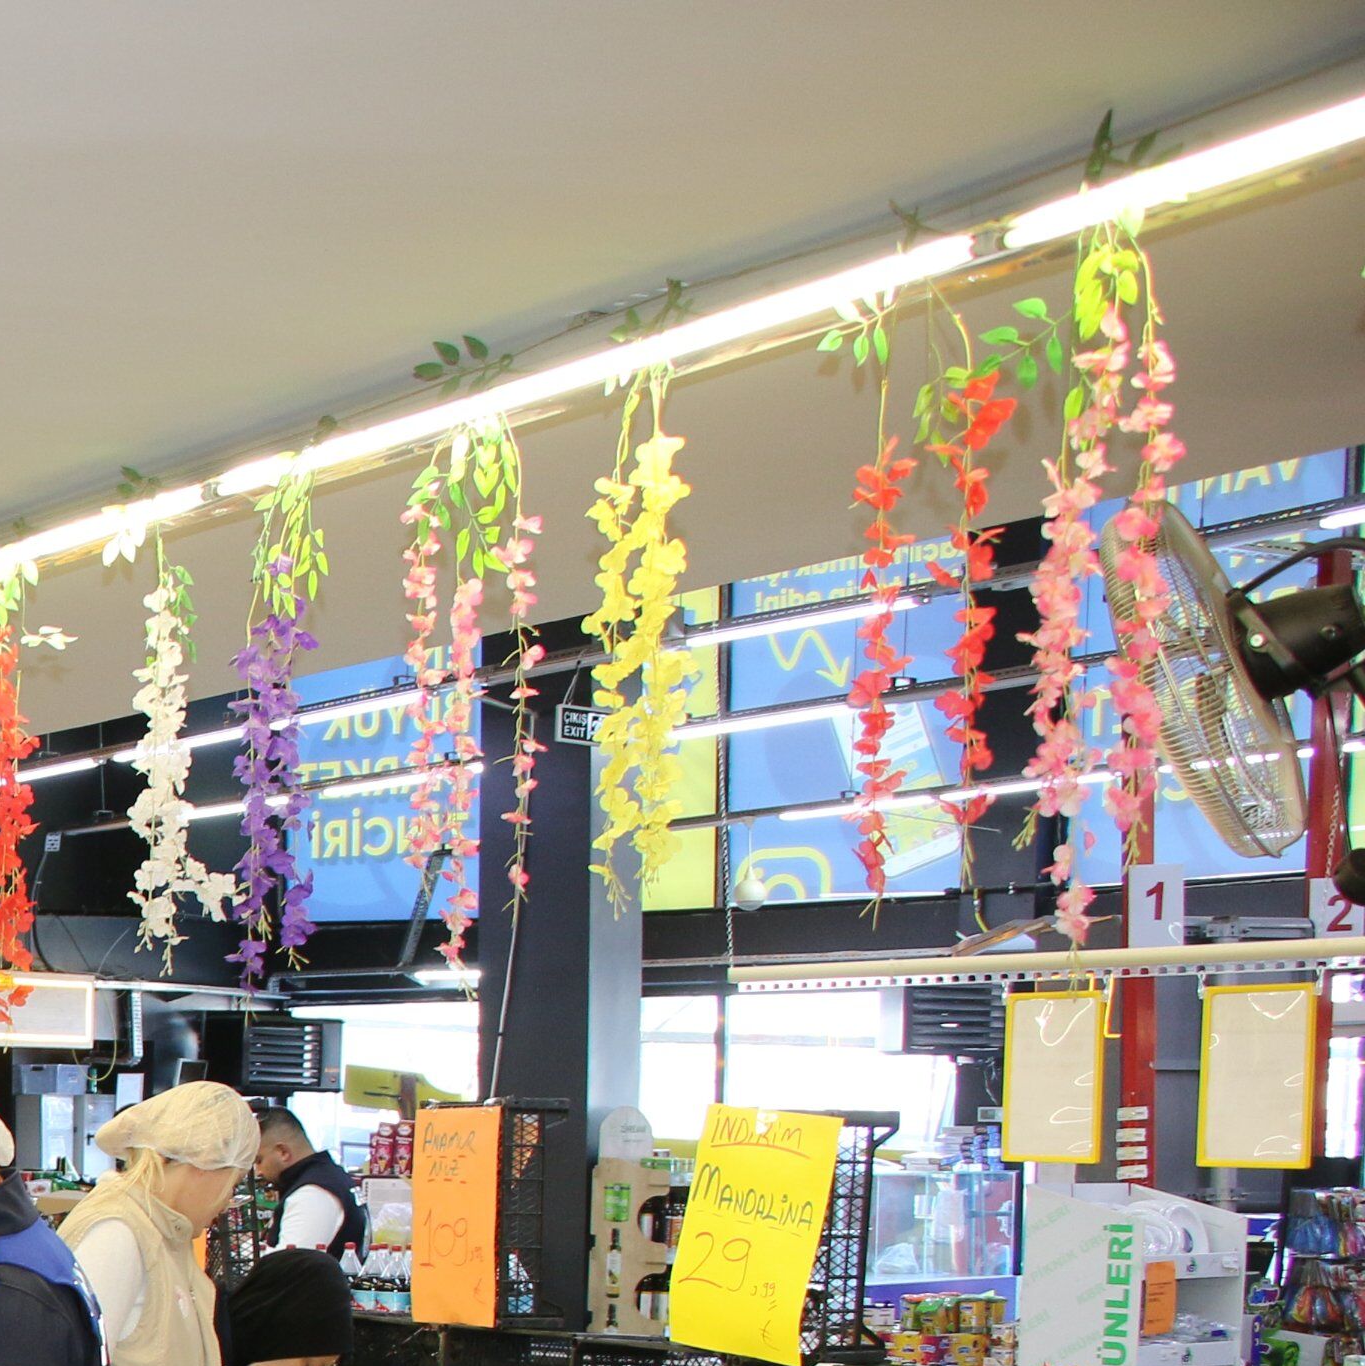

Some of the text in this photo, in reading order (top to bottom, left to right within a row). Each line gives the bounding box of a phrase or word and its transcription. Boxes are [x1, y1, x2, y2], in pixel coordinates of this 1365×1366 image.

[563, 725, 585, 738] EXIT
[564, 711, 587, 726] ÇIKIŞ
[1146, 881, 1164, 921] 1
[1326, 894, 1353, 932] 2
